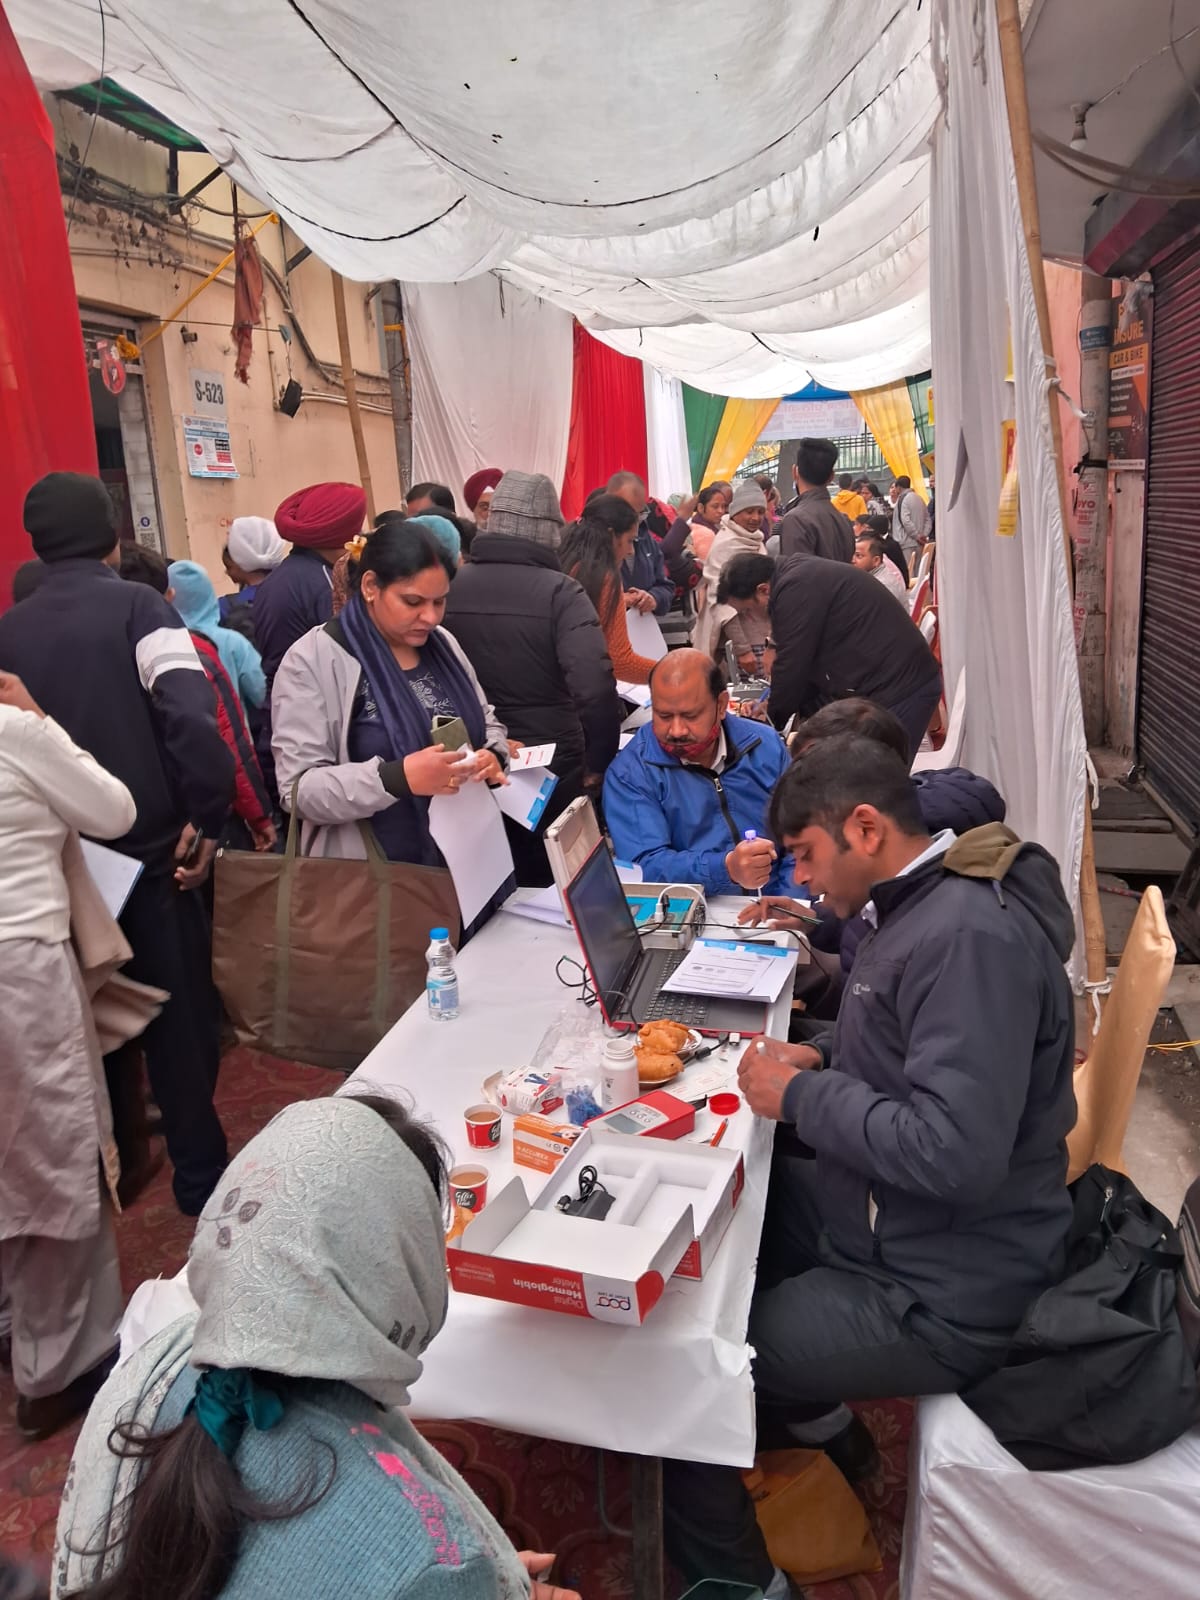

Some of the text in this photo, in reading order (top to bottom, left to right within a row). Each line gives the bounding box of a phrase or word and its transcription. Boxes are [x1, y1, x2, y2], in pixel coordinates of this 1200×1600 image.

[194, 379, 224, 405] S-523
[512, 1277, 582, 1300] Hemoglobin
[551, 1276, 581, 1289] Meter
[553, 1296, 584, 1309] Digital
